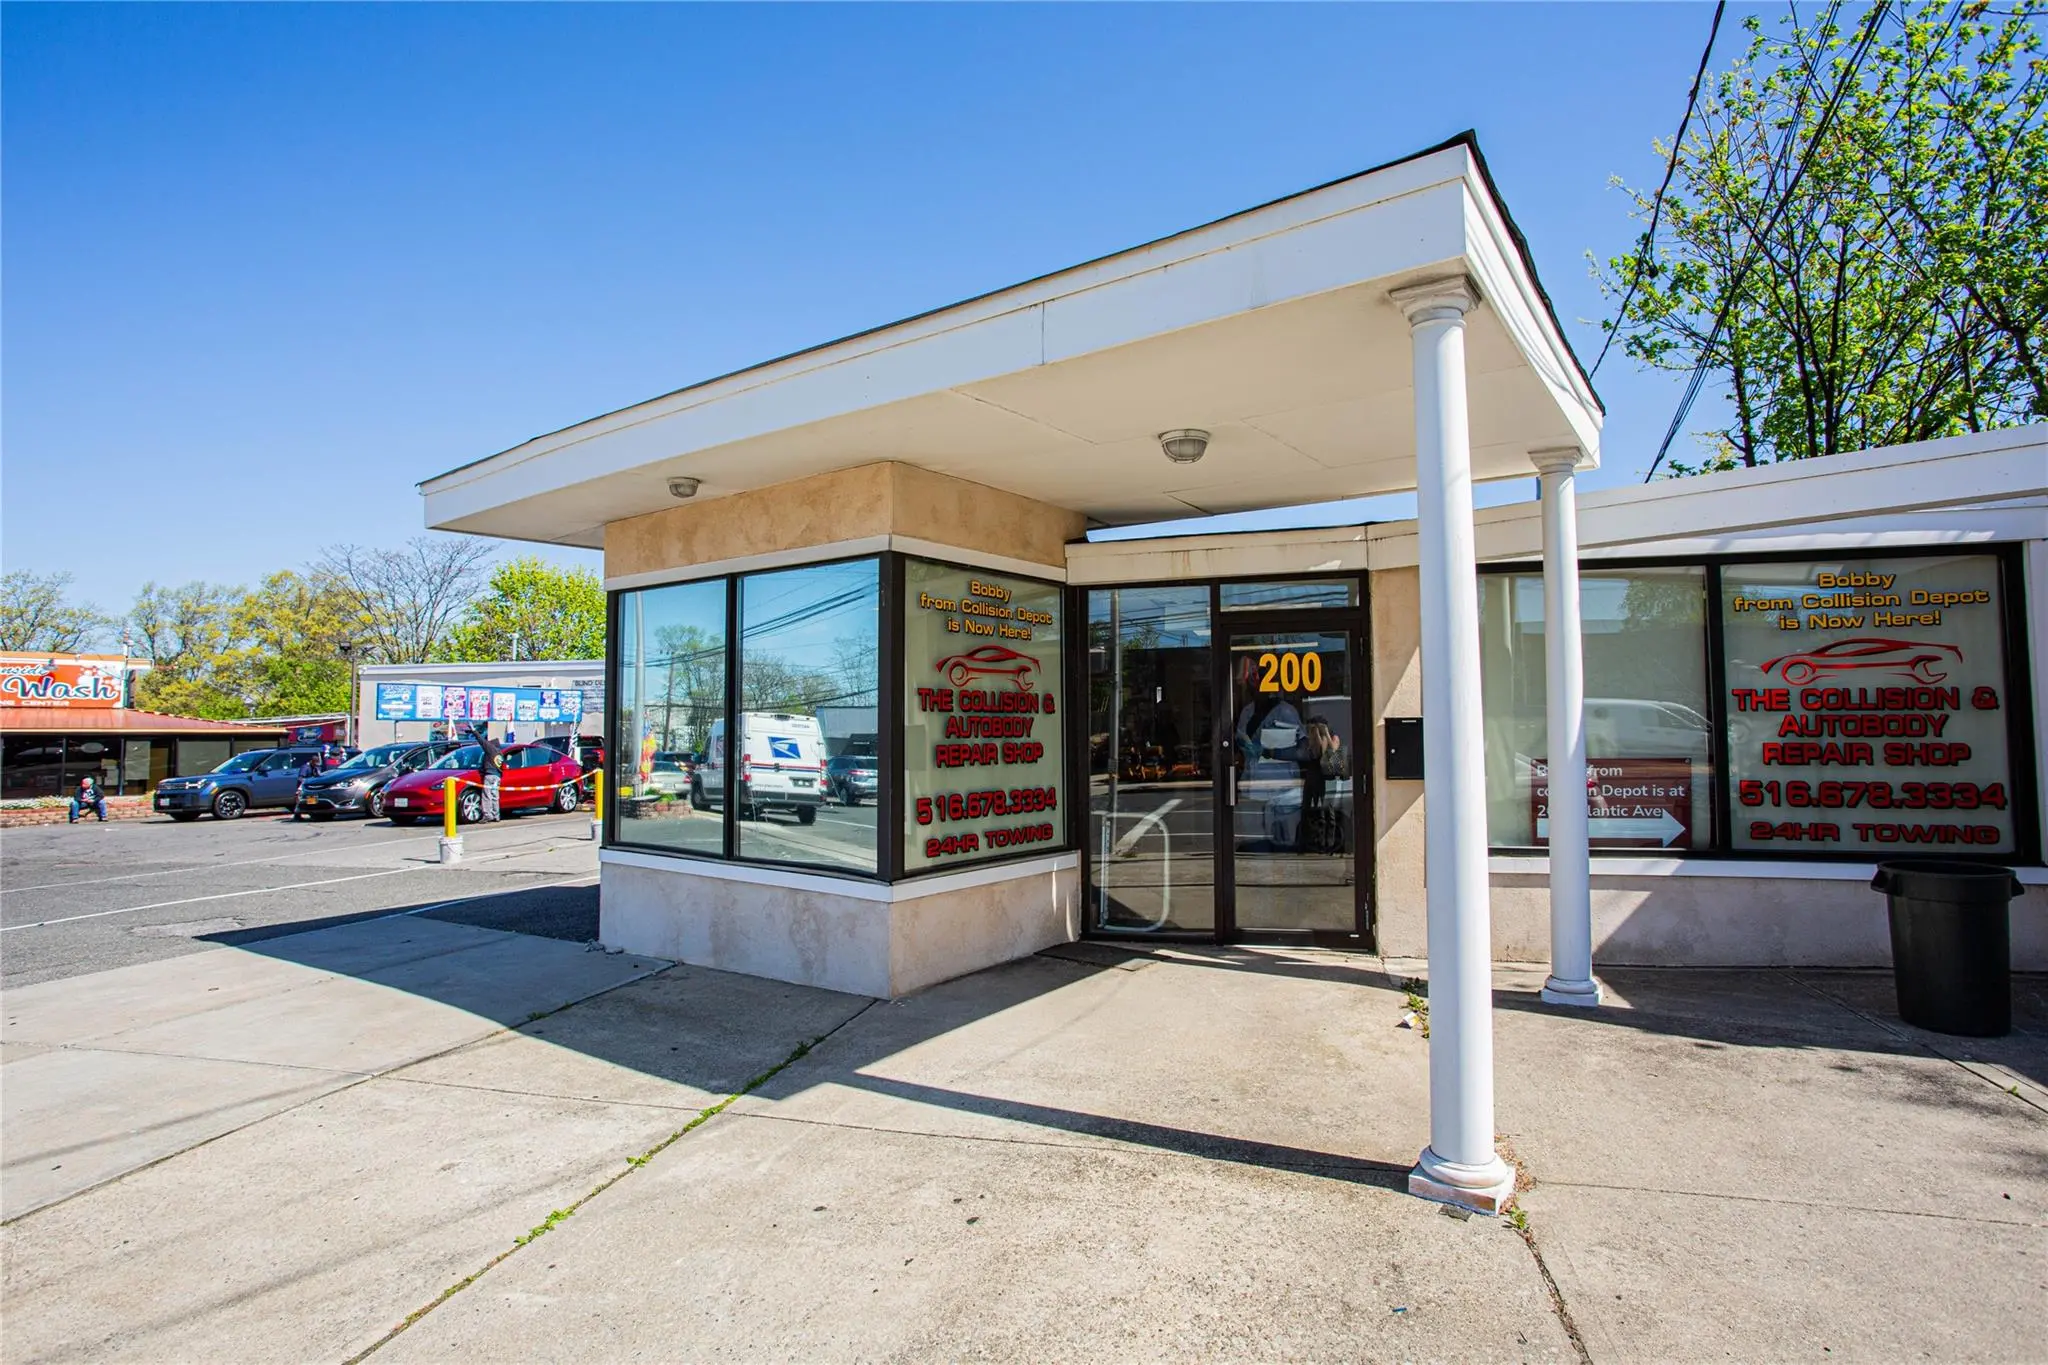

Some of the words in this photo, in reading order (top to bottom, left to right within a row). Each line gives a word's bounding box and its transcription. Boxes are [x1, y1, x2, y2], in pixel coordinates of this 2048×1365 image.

[970, 580, 1012, 602] Bobby
[1818, 572, 1895, 590] Bobby
[919, 591, 957, 611] from
[960, 598, 1014, 619] Collision
[1016, 606, 1053, 625] Depot
[1733, 596, 1793, 611] from
[1802, 593, 1901, 609] Collision
[1910, 589, 1990, 606] Depot
[947, 617, 961, 633] is
[964, 618, 996, 636] Now
[998, 623, 1032, 641] Here!
[1779, 615, 1800, 630] is
[1808, 614, 1864, 629] Now
[1873, 610, 1942, 627] Here!
[1258, 651, 1322, 693] 200
[3, 676, 118, 699] Wash
[1732, 688, 1790, 711] THE
[1800, 687, 1960, 711] COLLISION
[1971, 687, 1999, 710] &
[917, 688, 954, 711] THE
[959, 691, 1040, 712] COLLISION
[1043, 693, 1056, 713] &
[945, 716, 1034, 738] AUTOBODY
[1778, 714, 1949, 737] AUTOBODY
[935, 743, 998, 767] REPAIR
[1003, 742, 1043, 763] SHOP
[1762, 742, 1873, 765] REPAIR
[1884, 742, 1972, 766] SHOP
[1586, 765, 1622, 777] from
[1601, 785, 1648, 799] Depot
[1652, 785, 1664, 796] is
[1669, 786, 1685, 797] at
[1738, 780, 2006, 810] 516.678.3334
[916, 788, 1057, 825] 516.678.3334
[1587, 804, 1629, 817] lantic
[926, 834, 980, 858] 24HR
[985, 823, 1054, 849] TOWING
[1750, 821, 1841, 843] 24HR
[1853, 823, 2000, 845] TOWING
